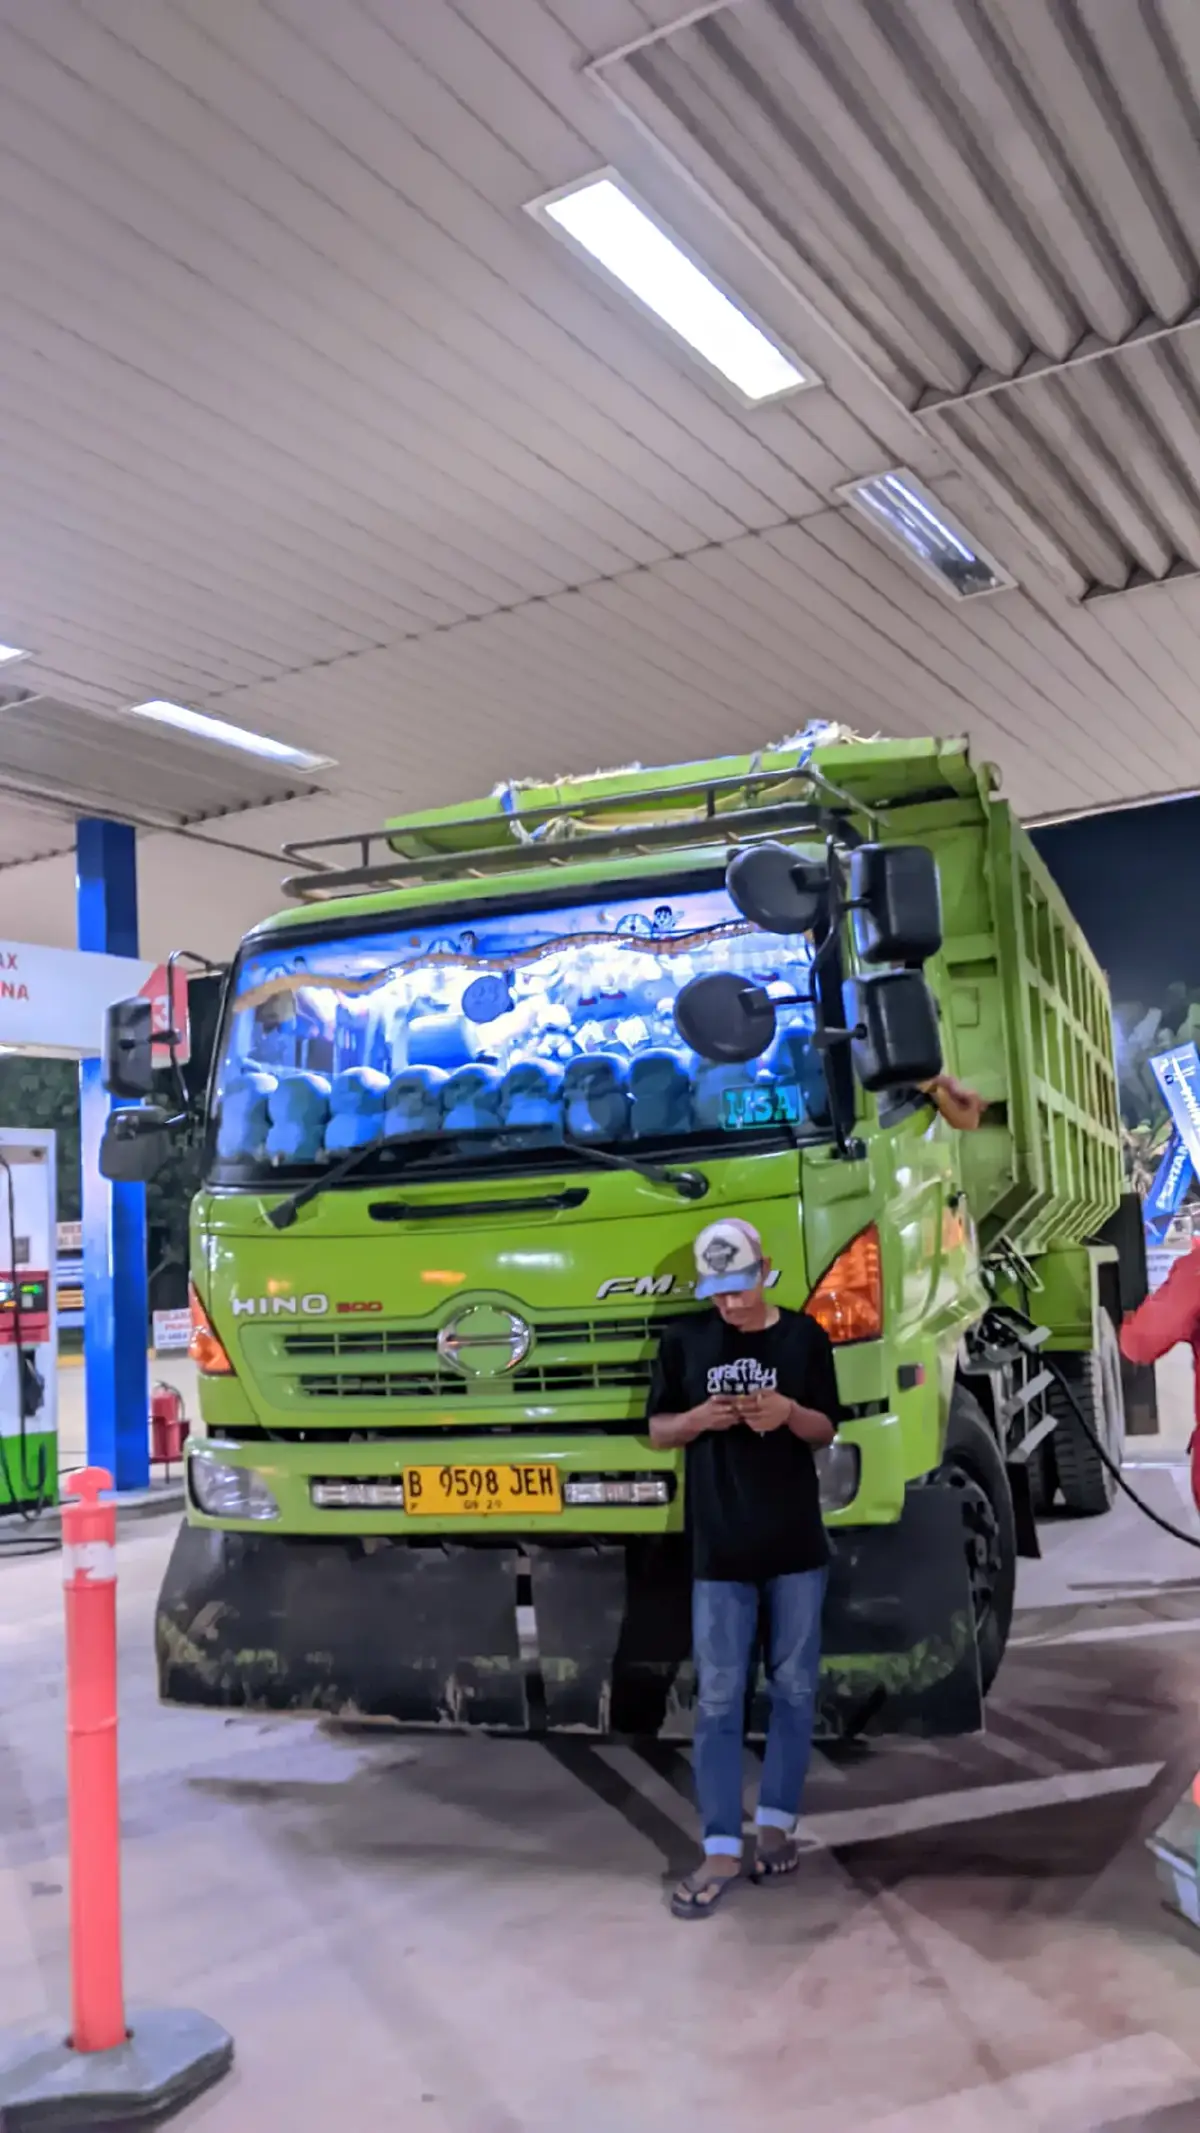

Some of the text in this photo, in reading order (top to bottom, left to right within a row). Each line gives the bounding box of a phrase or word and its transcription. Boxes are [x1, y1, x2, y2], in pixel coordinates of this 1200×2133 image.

[232, 1293, 329, 1317] HINO
[408, 1467, 553, 1498] B 9598 JEH
